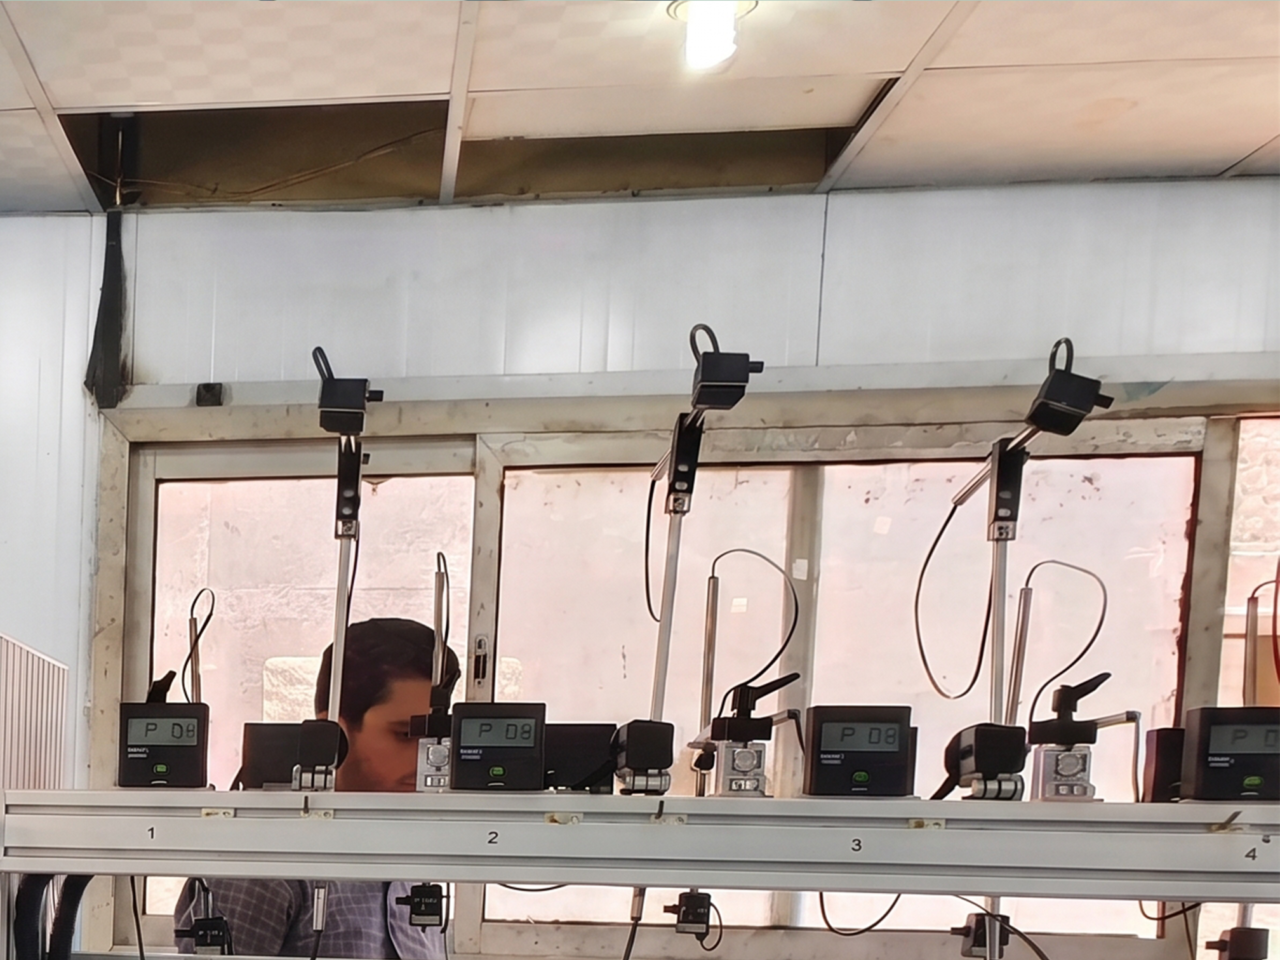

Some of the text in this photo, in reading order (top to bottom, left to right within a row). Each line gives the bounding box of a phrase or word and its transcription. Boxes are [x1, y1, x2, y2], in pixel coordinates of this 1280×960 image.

[147, 826, 154, 840] 1
[487, 831, 499, 844] 2
[851, 838, 862, 852] 3
[1245, 847, 1257, 861] 4
